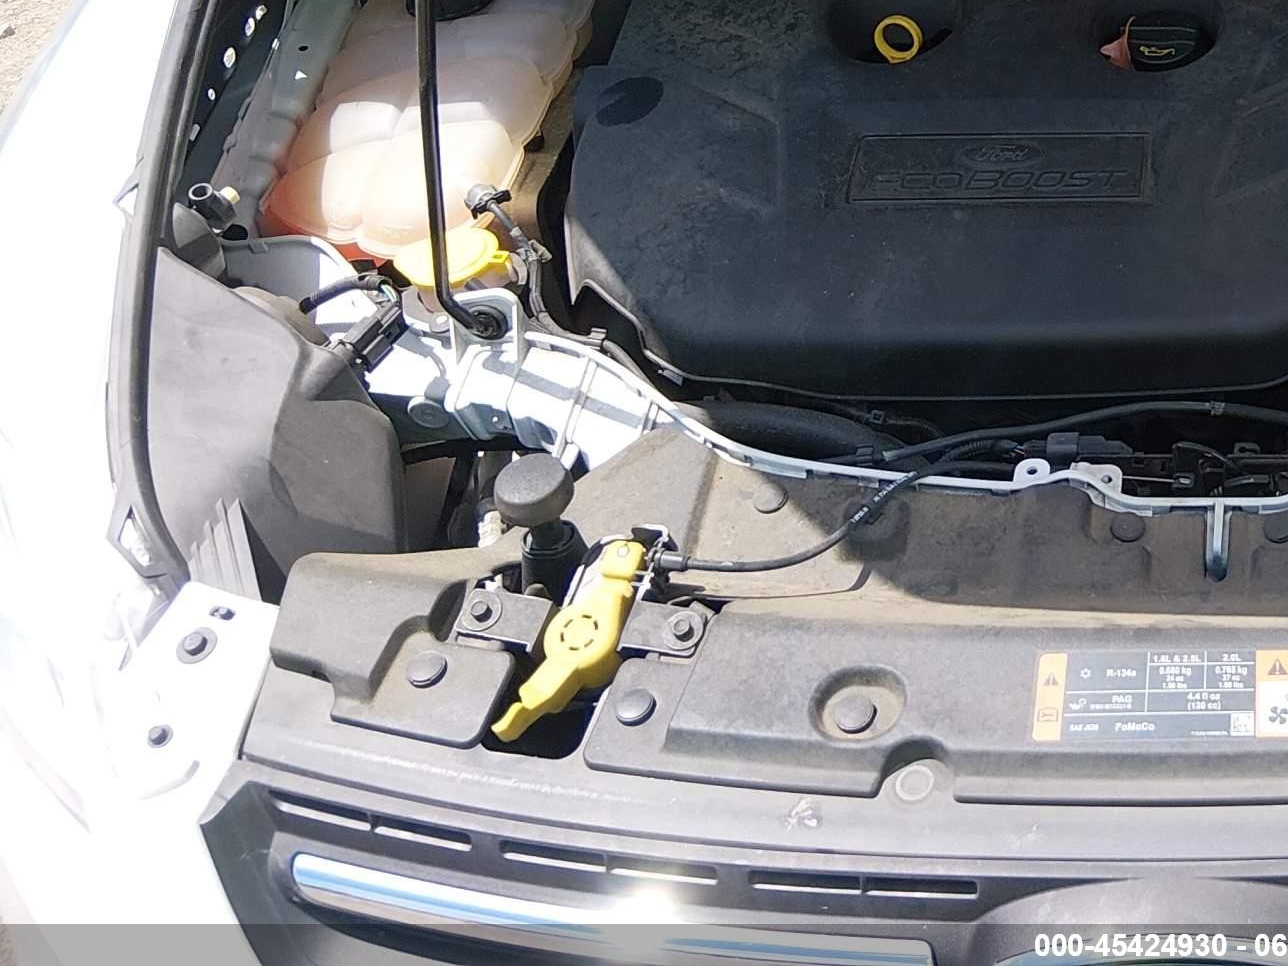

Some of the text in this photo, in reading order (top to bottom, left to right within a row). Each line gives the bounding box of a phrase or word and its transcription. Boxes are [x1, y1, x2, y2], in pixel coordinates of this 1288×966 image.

[974, 143, 1031, 162] Ford
[1221, 653, 1242, 662] 2.0L
[1106, 668, 1137, 678] R-134a
[1181, 666, 1192, 676] kg
[1238, 665, 1248, 676] kg
[1111, 694, 1132, 703] PAG
[1114, 721, 1155, 732] FoMoCo
